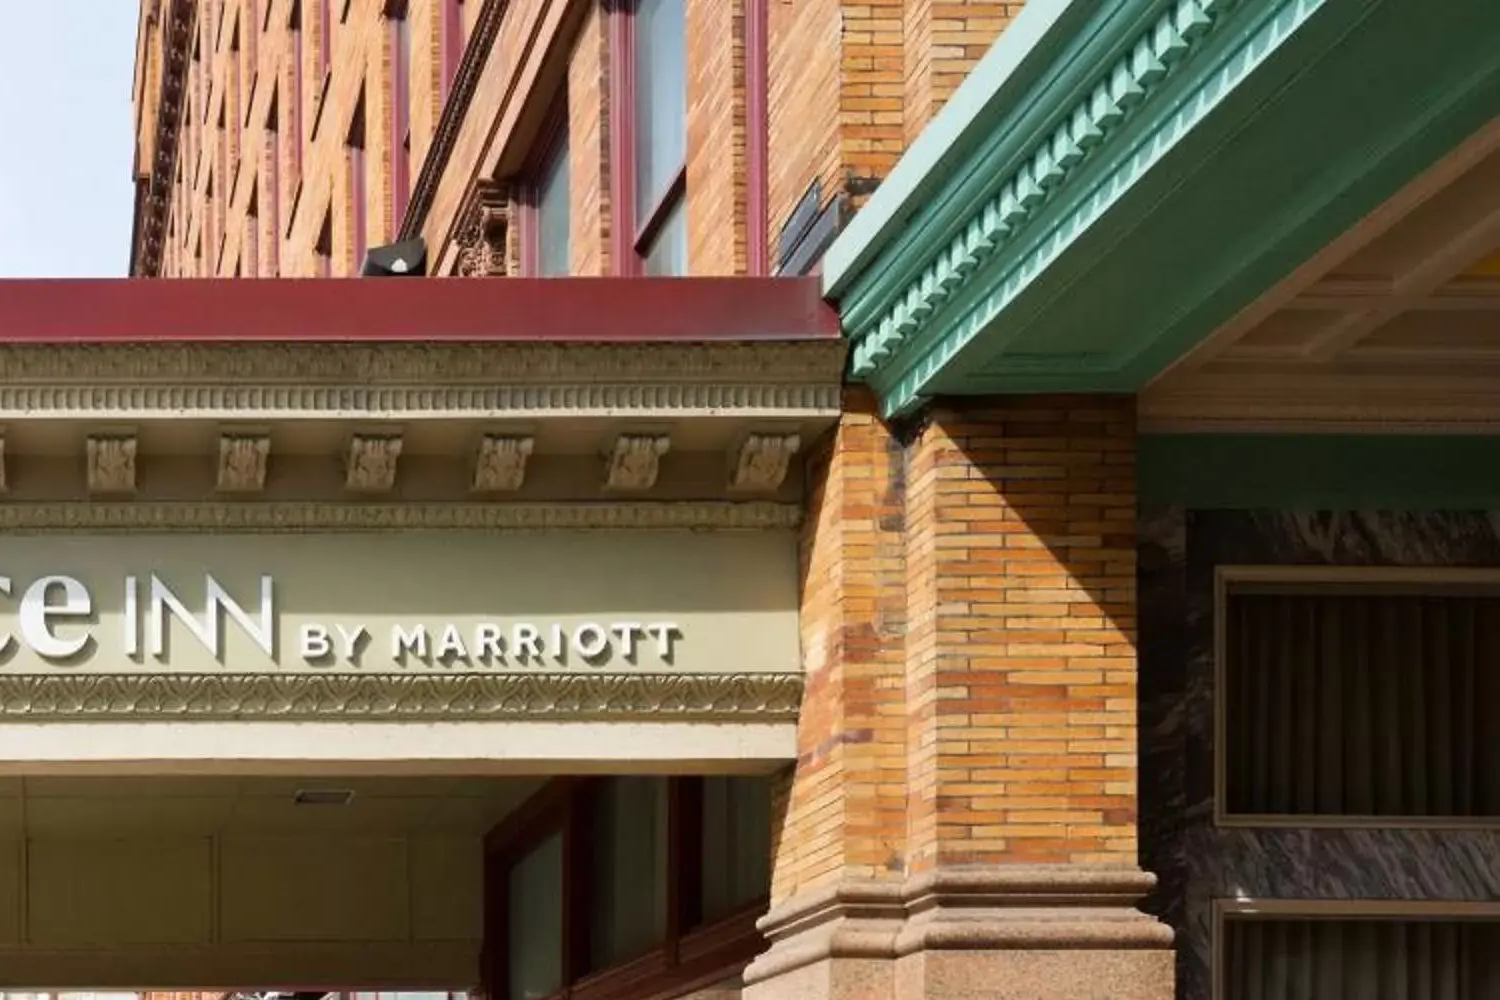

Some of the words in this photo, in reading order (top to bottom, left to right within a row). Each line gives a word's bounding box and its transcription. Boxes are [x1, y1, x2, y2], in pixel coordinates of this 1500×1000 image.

[125, 573, 273, 659] INN
[300, 623, 367, 658] BY
[393, 622, 680, 658] MARRIOTT
